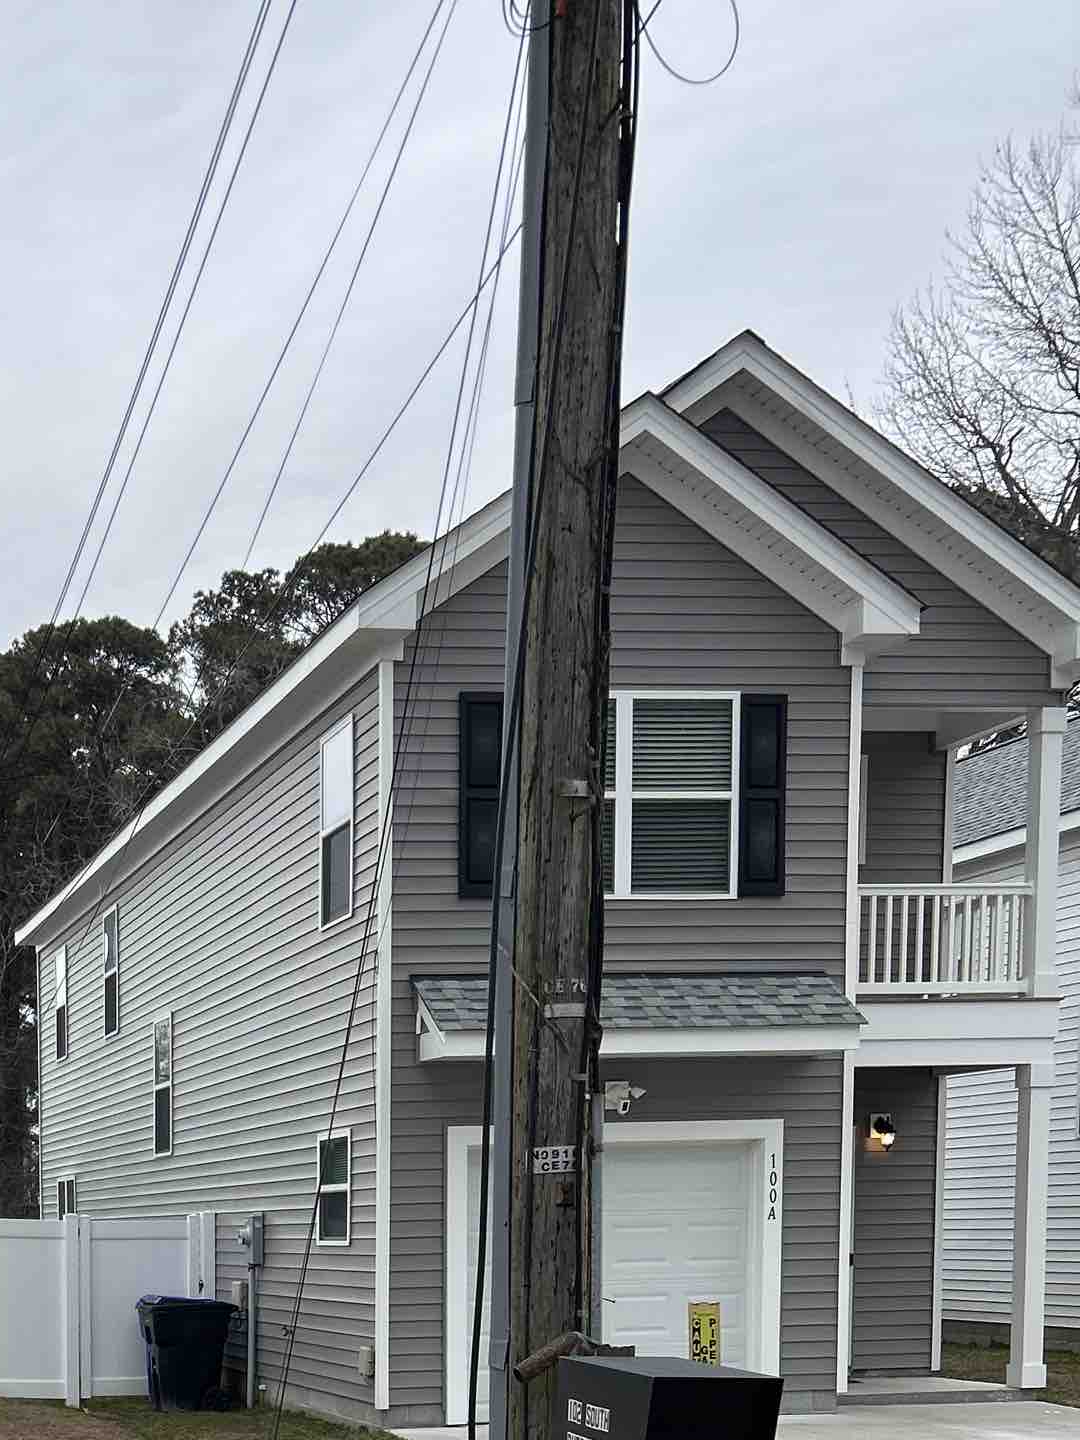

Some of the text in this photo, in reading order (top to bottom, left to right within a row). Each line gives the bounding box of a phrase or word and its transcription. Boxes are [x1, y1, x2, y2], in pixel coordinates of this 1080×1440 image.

[768, 1152, 777, 1221] 100A
[709, 1318, 717, 1363] PIPE
[569, 1400, 609, 1432] 102 SOUTH
